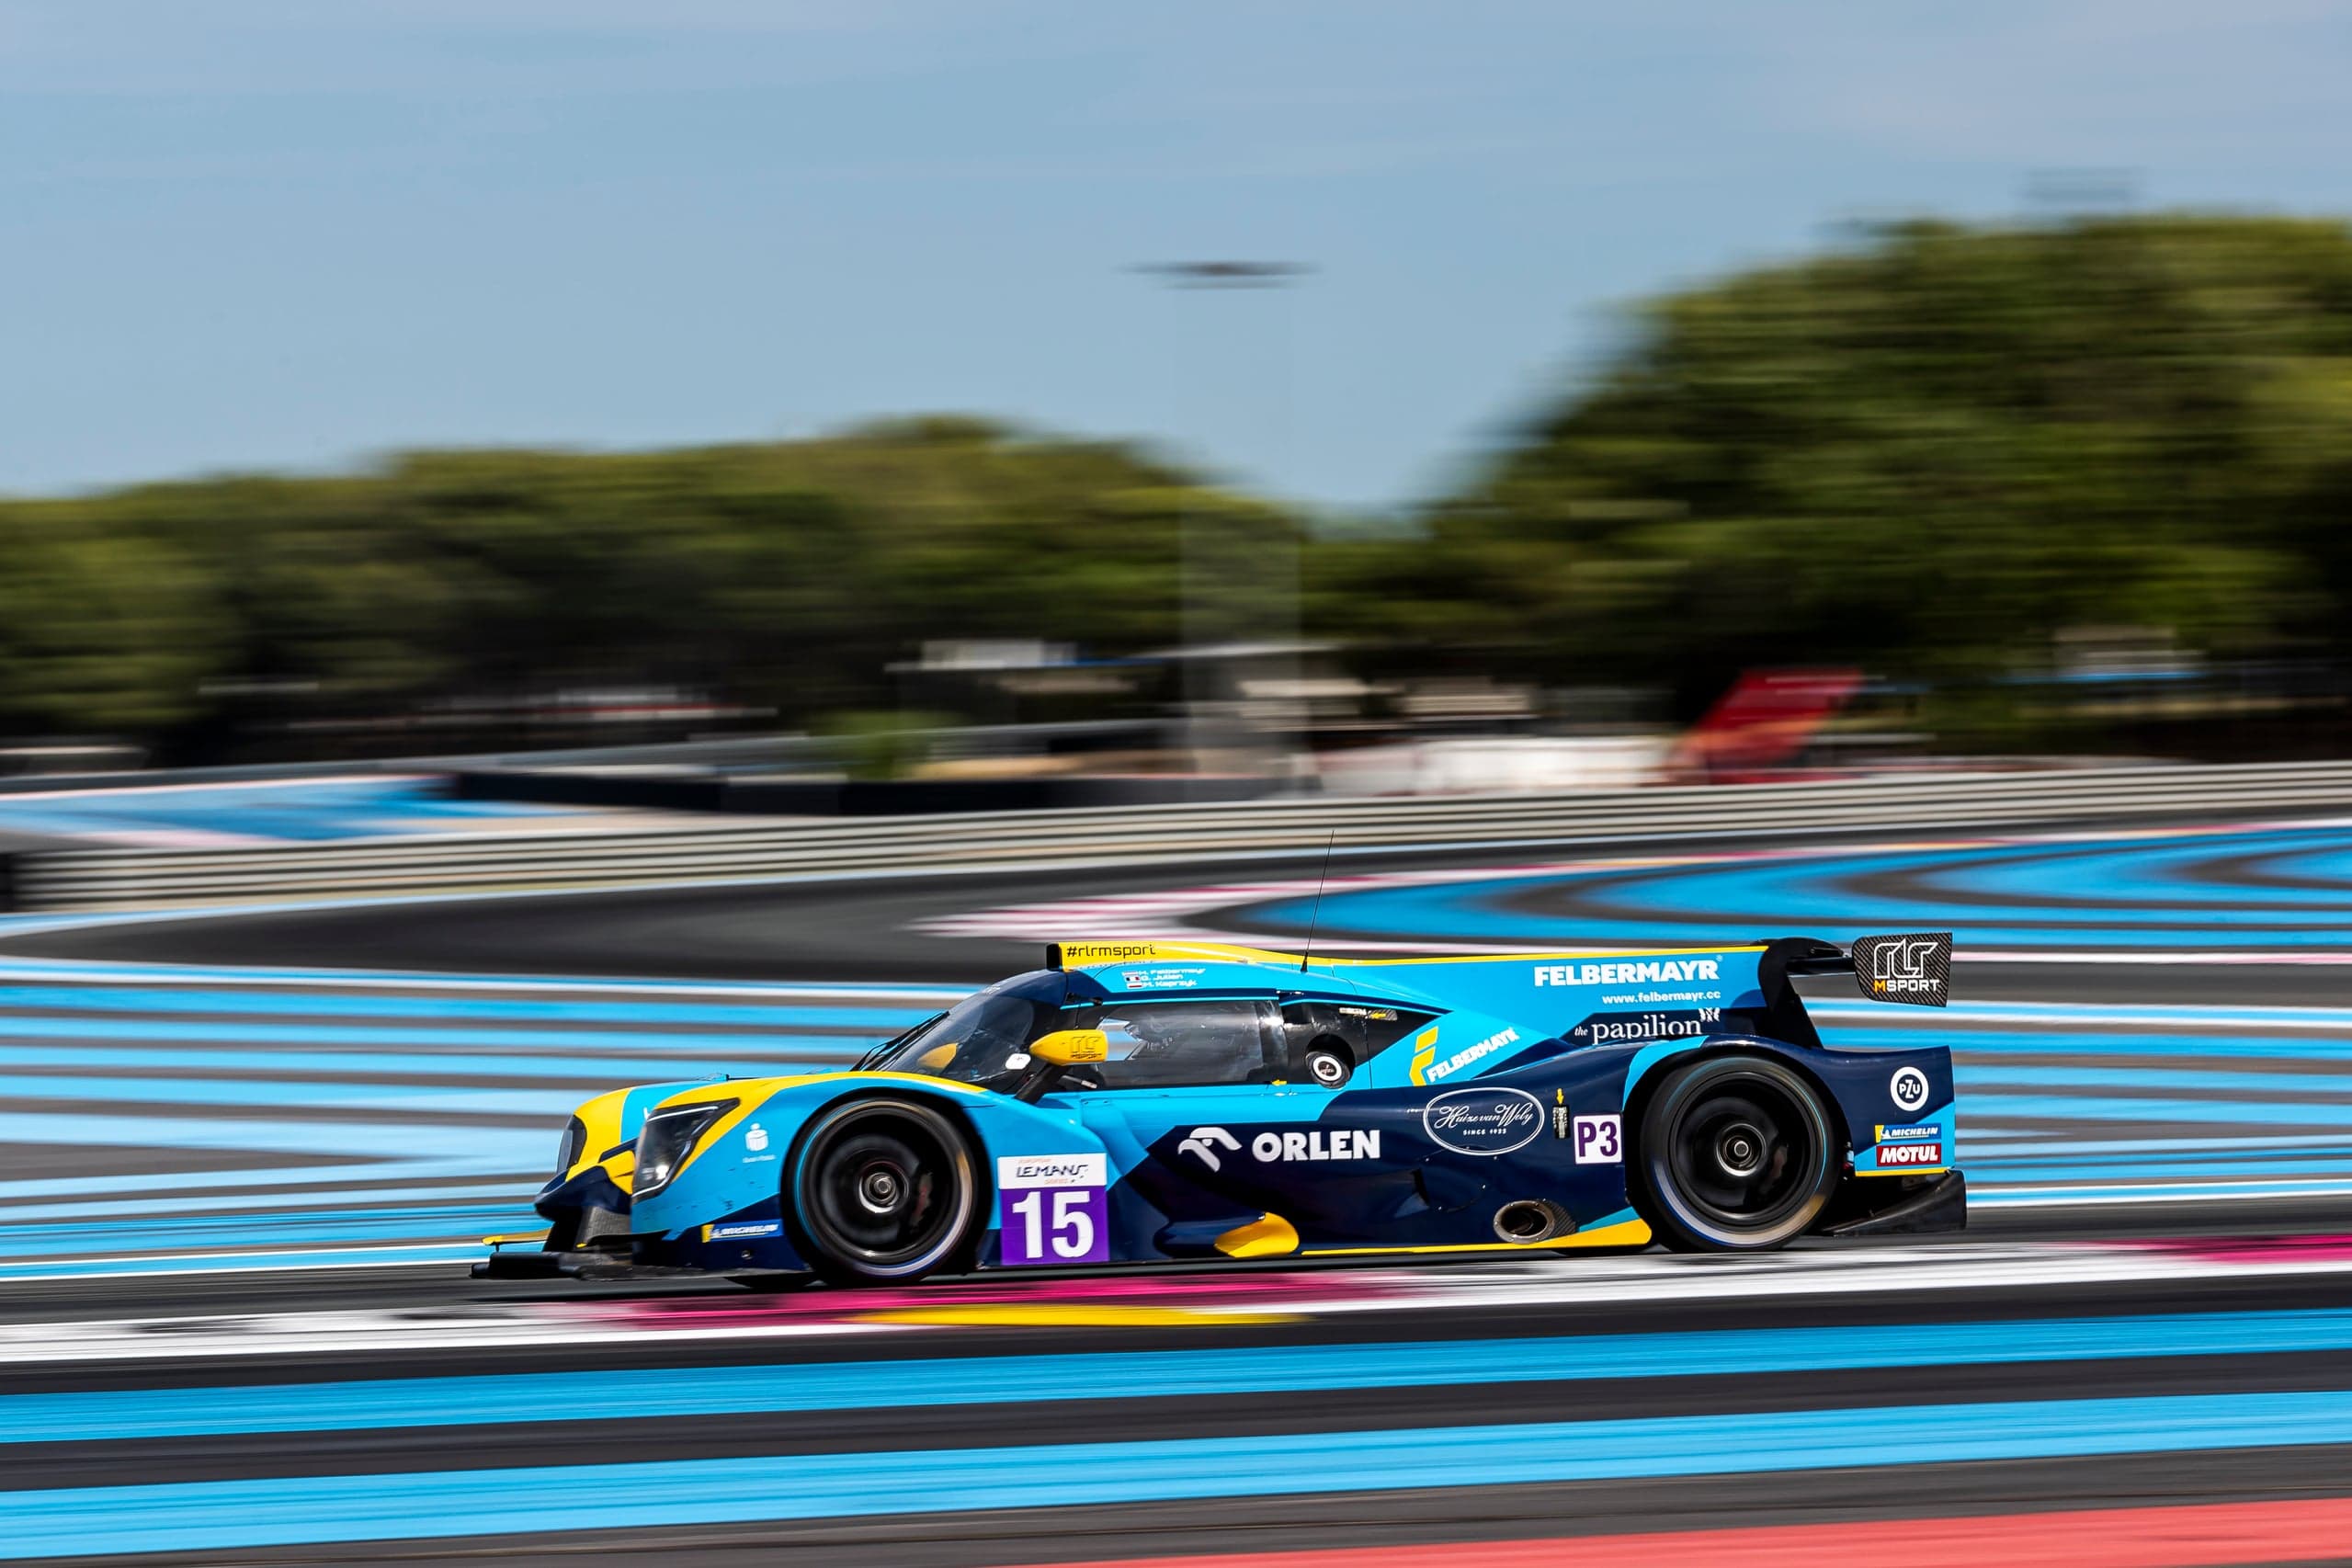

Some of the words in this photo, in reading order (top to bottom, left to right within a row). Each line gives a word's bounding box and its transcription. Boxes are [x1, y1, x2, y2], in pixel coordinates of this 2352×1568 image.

[1602, 990, 1721, 1005] www.felbermayr.cc
[1873, 979, 1940, 993] MSPORT
[1574, 1026, 1588, 1037] the
[1591, 1014, 1702, 1046] papilion
[1426, 1027, 1520, 1083] FELBERMAYR
[1899, 1079, 1921, 1099] PZU
[1577, 1121, 1619, 1157] P3
[1892, 1127, 1938, 1137] MICHELIN
[1252, 1130, 1381, 1163] ORLEN
[1880, 1145, 1938, 1164] MOTUL
[1012, 1190, 1095, 1259] 15
